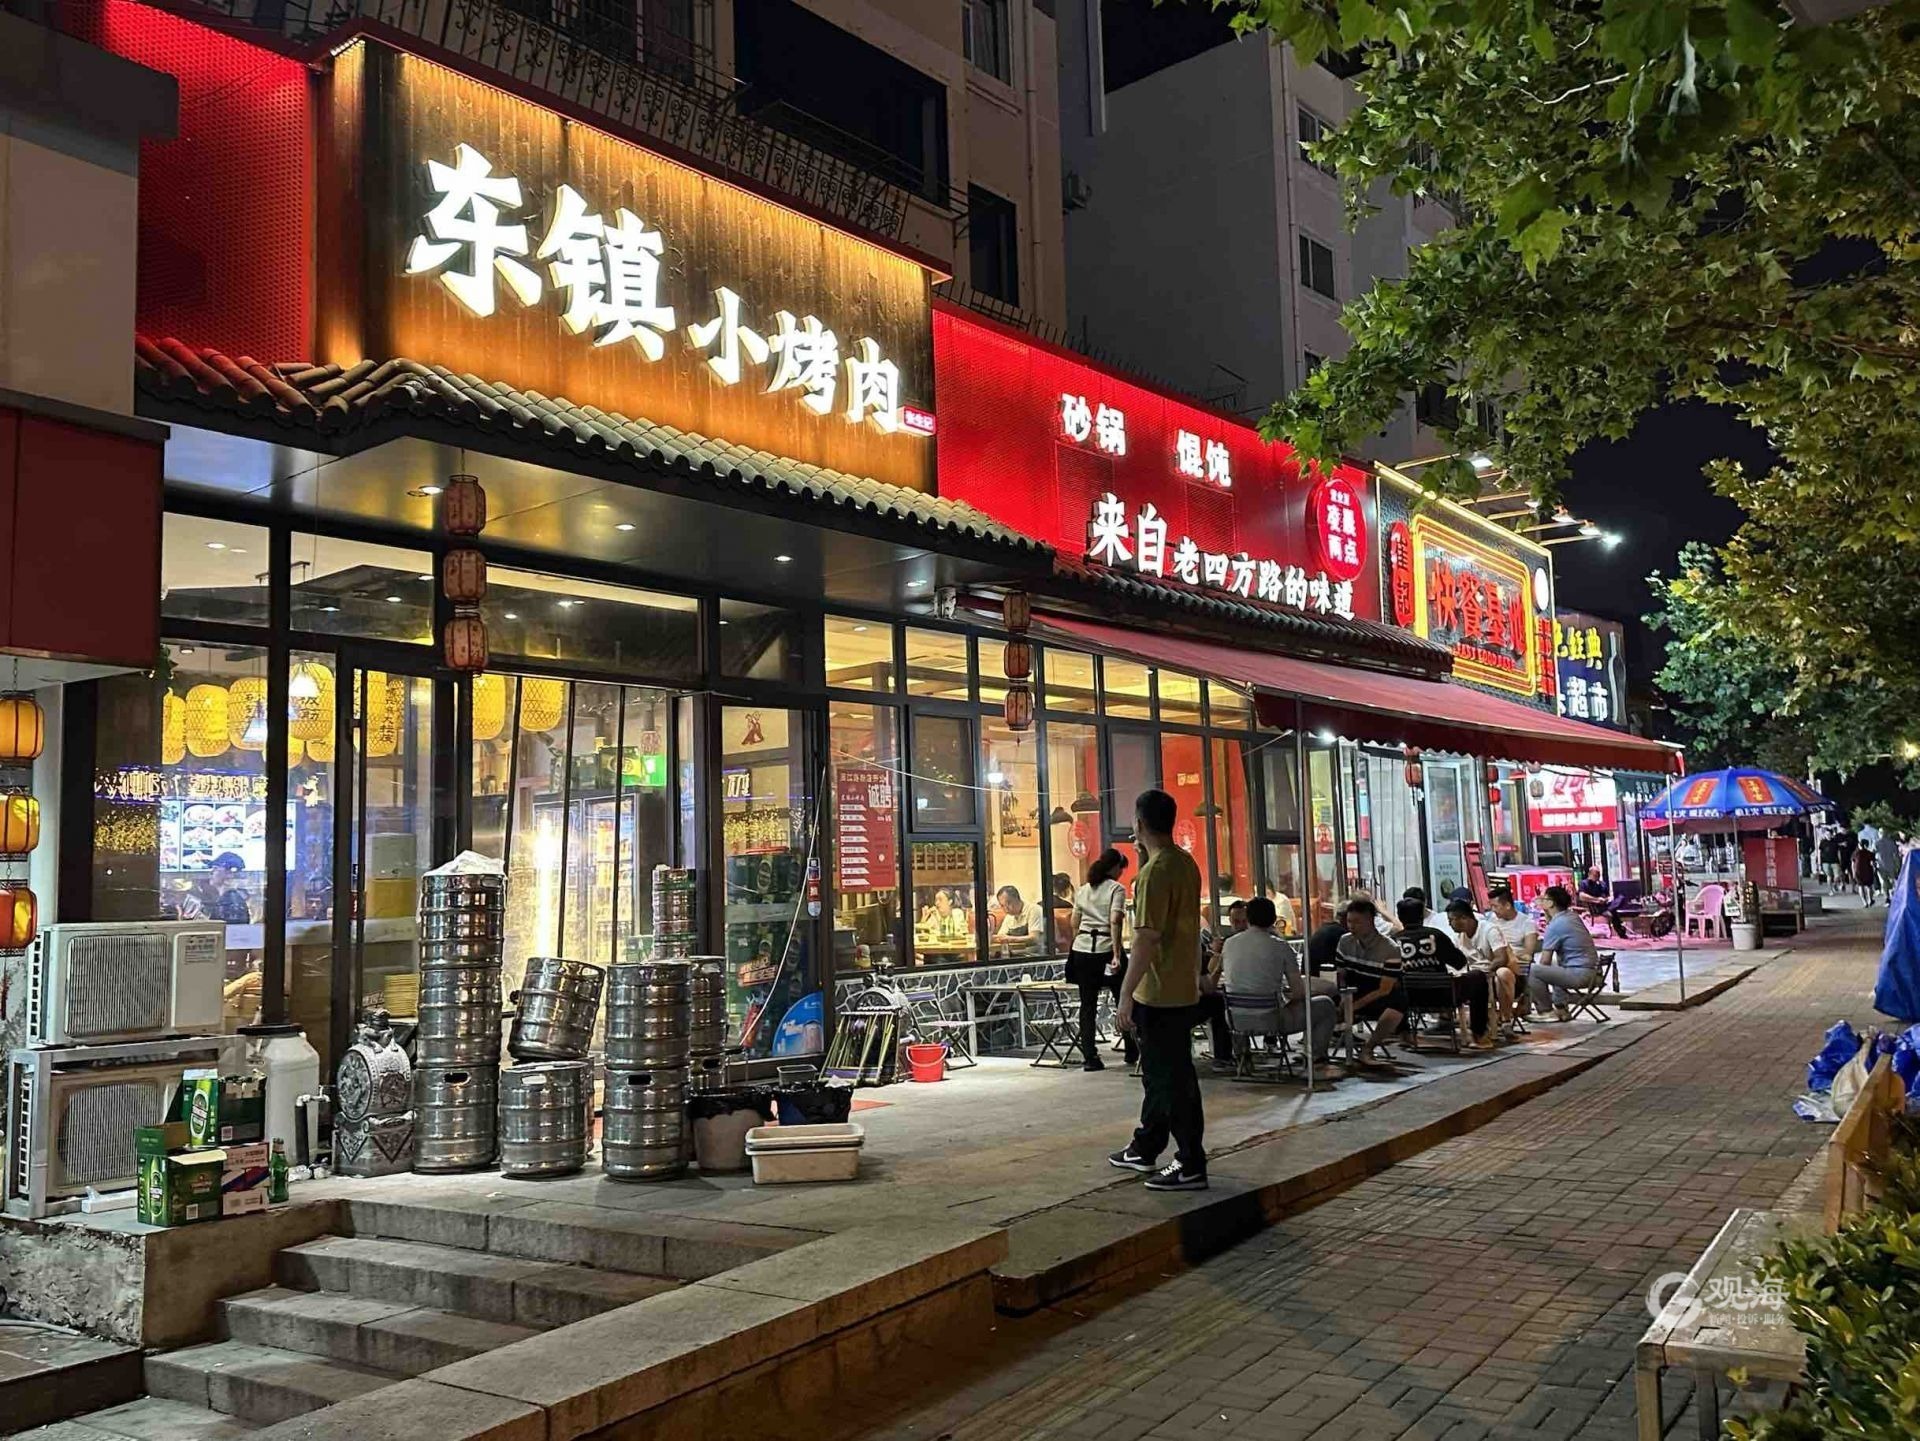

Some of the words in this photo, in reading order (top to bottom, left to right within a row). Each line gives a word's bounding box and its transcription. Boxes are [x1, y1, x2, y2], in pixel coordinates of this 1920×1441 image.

[404, 143, 901, 434] 东镇小烤肉
[1061, 392, 1126, 456] 砂锅
[1089, 492, 1356, 621] 来自老四方路的味道
